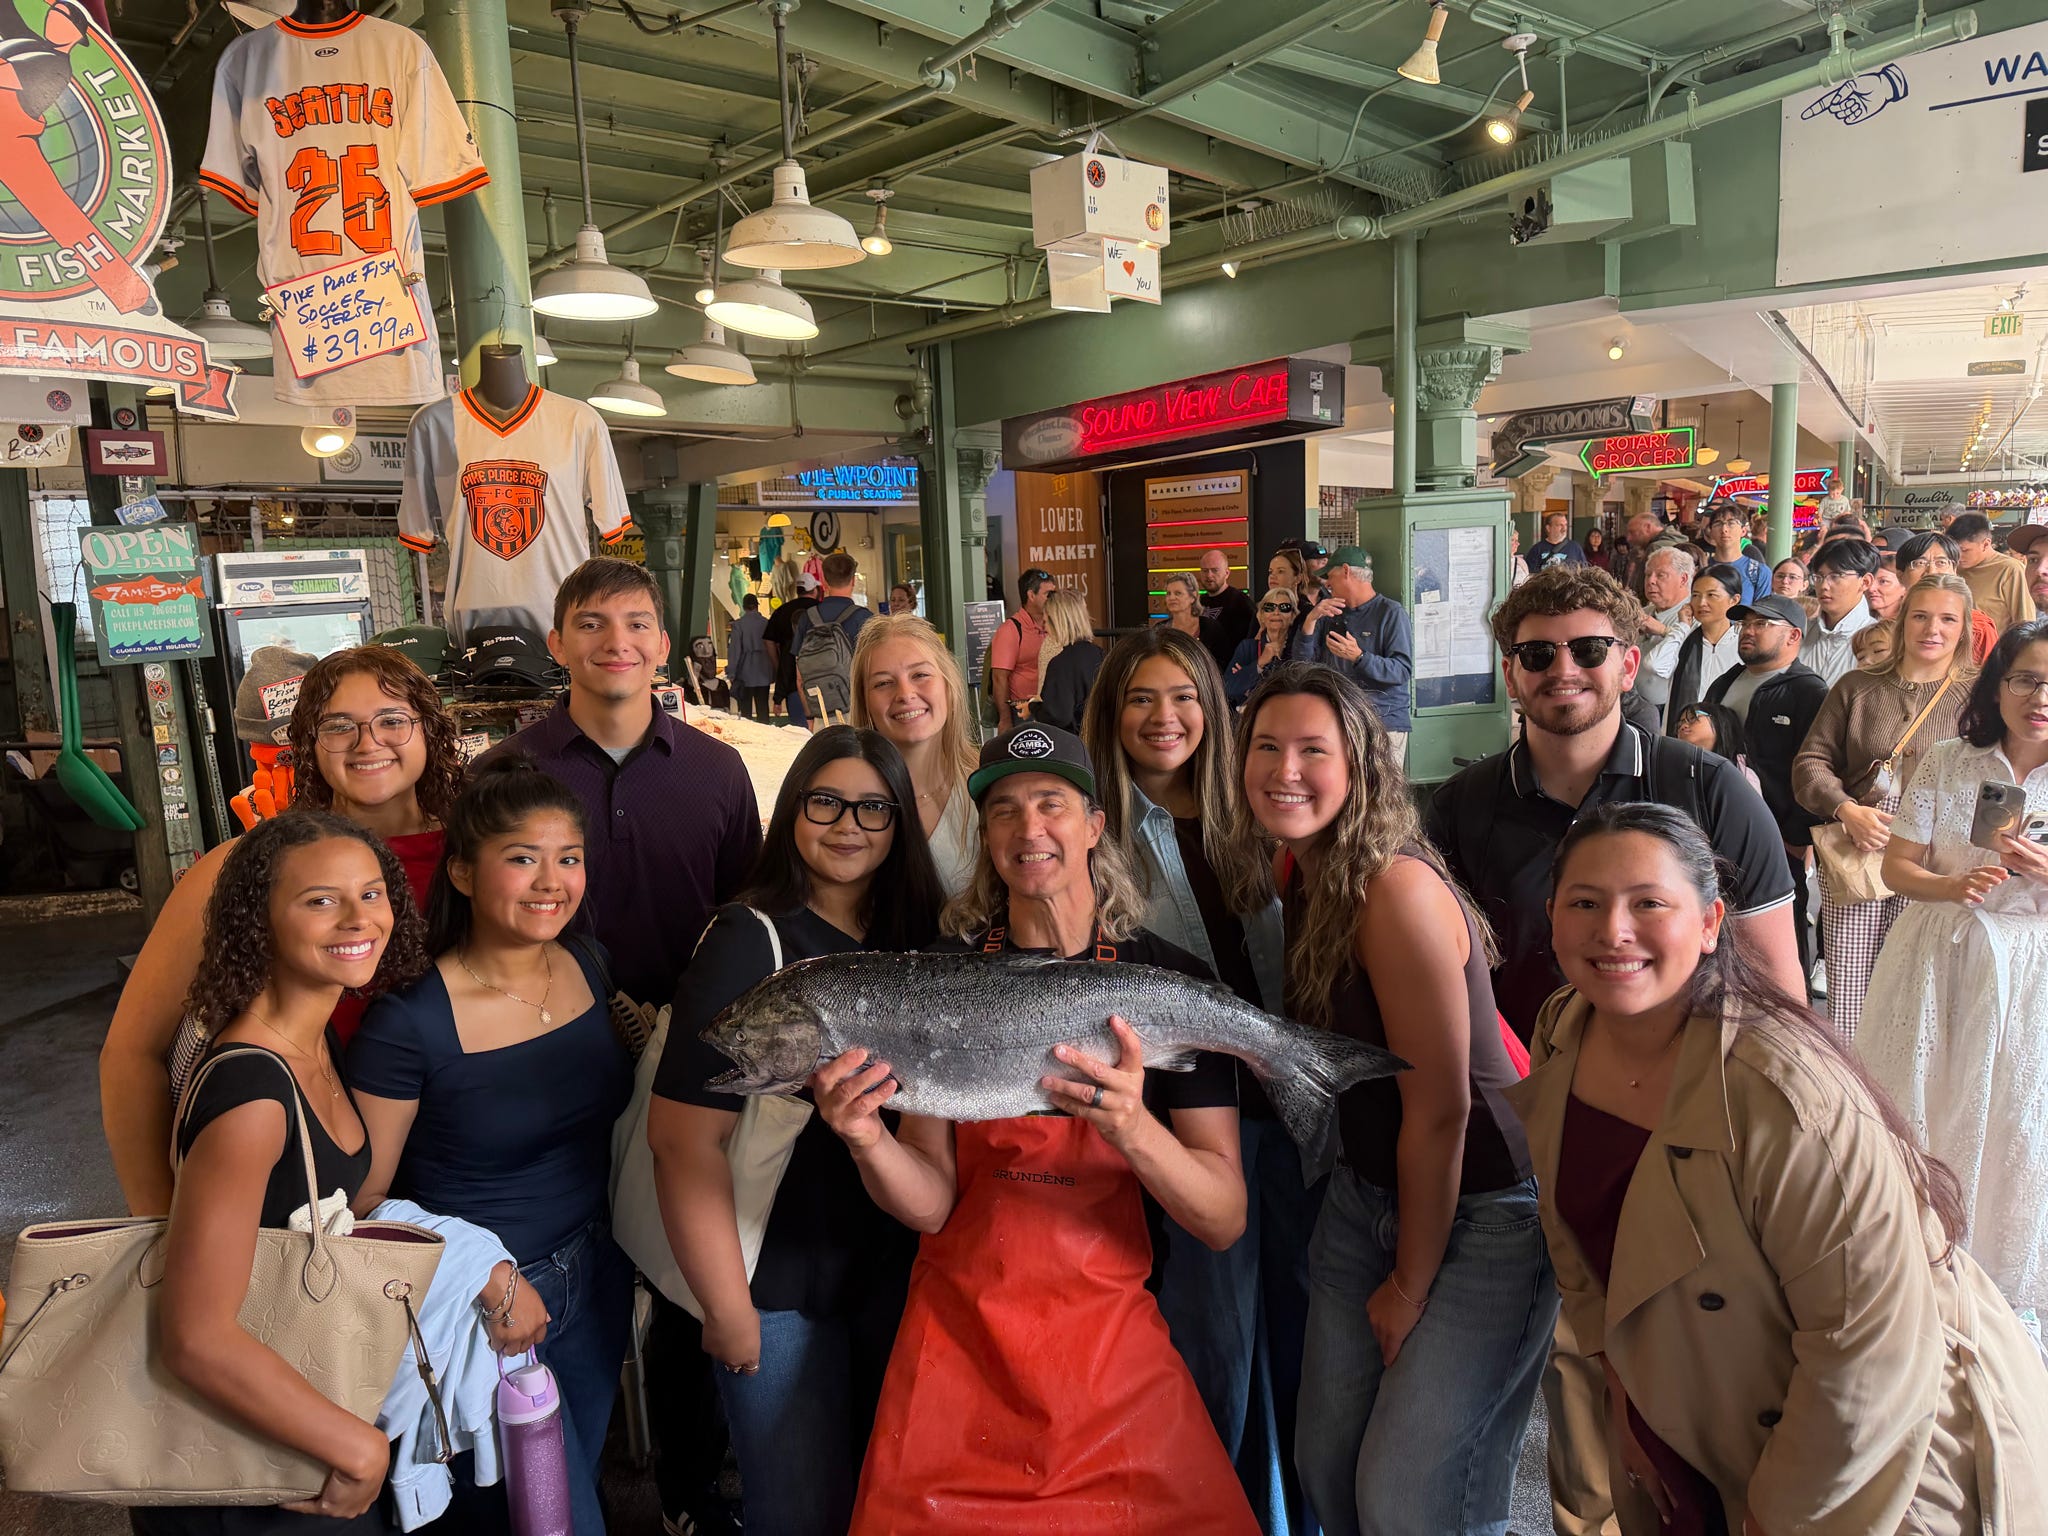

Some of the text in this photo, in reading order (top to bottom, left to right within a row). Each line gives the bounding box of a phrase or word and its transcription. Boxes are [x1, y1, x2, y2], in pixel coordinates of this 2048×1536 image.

[265, 83, 393, 138] SEATTLE
[83, 68, 153, 241] MARKET
[285, 143, 392, 257] 26
[1107, 242, 1127, 259] WE
[17, 233, 115, 288] FISH
[280, 259, 397, 310] PIKE PLACE FISH
[1136, 277, 1152, 290] YOU
[88, 300, 107, 311] TM
[297, 289, 368, 325] SOCCER
[321, 297, 386, 330] JERSEY
[1991, 316, 2019, 335] EXIT
[14, 327, 199, 377] FAMOUS
[1081, 400, 1156, 438] SOUND
[1165, 386, 1221, 423] VIEW
[1229, 372, 1288, 410] CAFE
[1605, 433, 1670, 451] ROTARY
[1592, 447, 1689, 470] GROCERY
[463, 469, 544, 487] PIKE PLACE FISH
[799, 465, 918, 487] VIEWPOINT
[817, 488, 903, 500] & PUBLIC SEATING
[1152, 481, 1237, 494] MARKET LEVELS
[1717, 480, 1765, 498] LOWER
[517, 497, 531, 505] 1930
[1905, 490, 1954, 505] Quality
[1040, 507, 1084, 532] LOWER
[82, 525, 190, 569] OPEN
[1029, 543, 1097, 562] MARKET
[135, 555, 198, 569] DAILY
[106, 587, 142, 601] 7AM
[151, 584, 187, 598] 5PM
[292, 578, 339, 594] SEAHAWKS
[1054, 572, 1088, 597] VELS
[111, 608, 130, 618] CALL
[113, 617, 195, 633] PIKEPLACEFISH.COM
[269, 694, 300, 710] BEANI
[1012, 740, 1049, 751] TAMBA
[992, 1169, 1076, 1187] GRUNDÉNS
